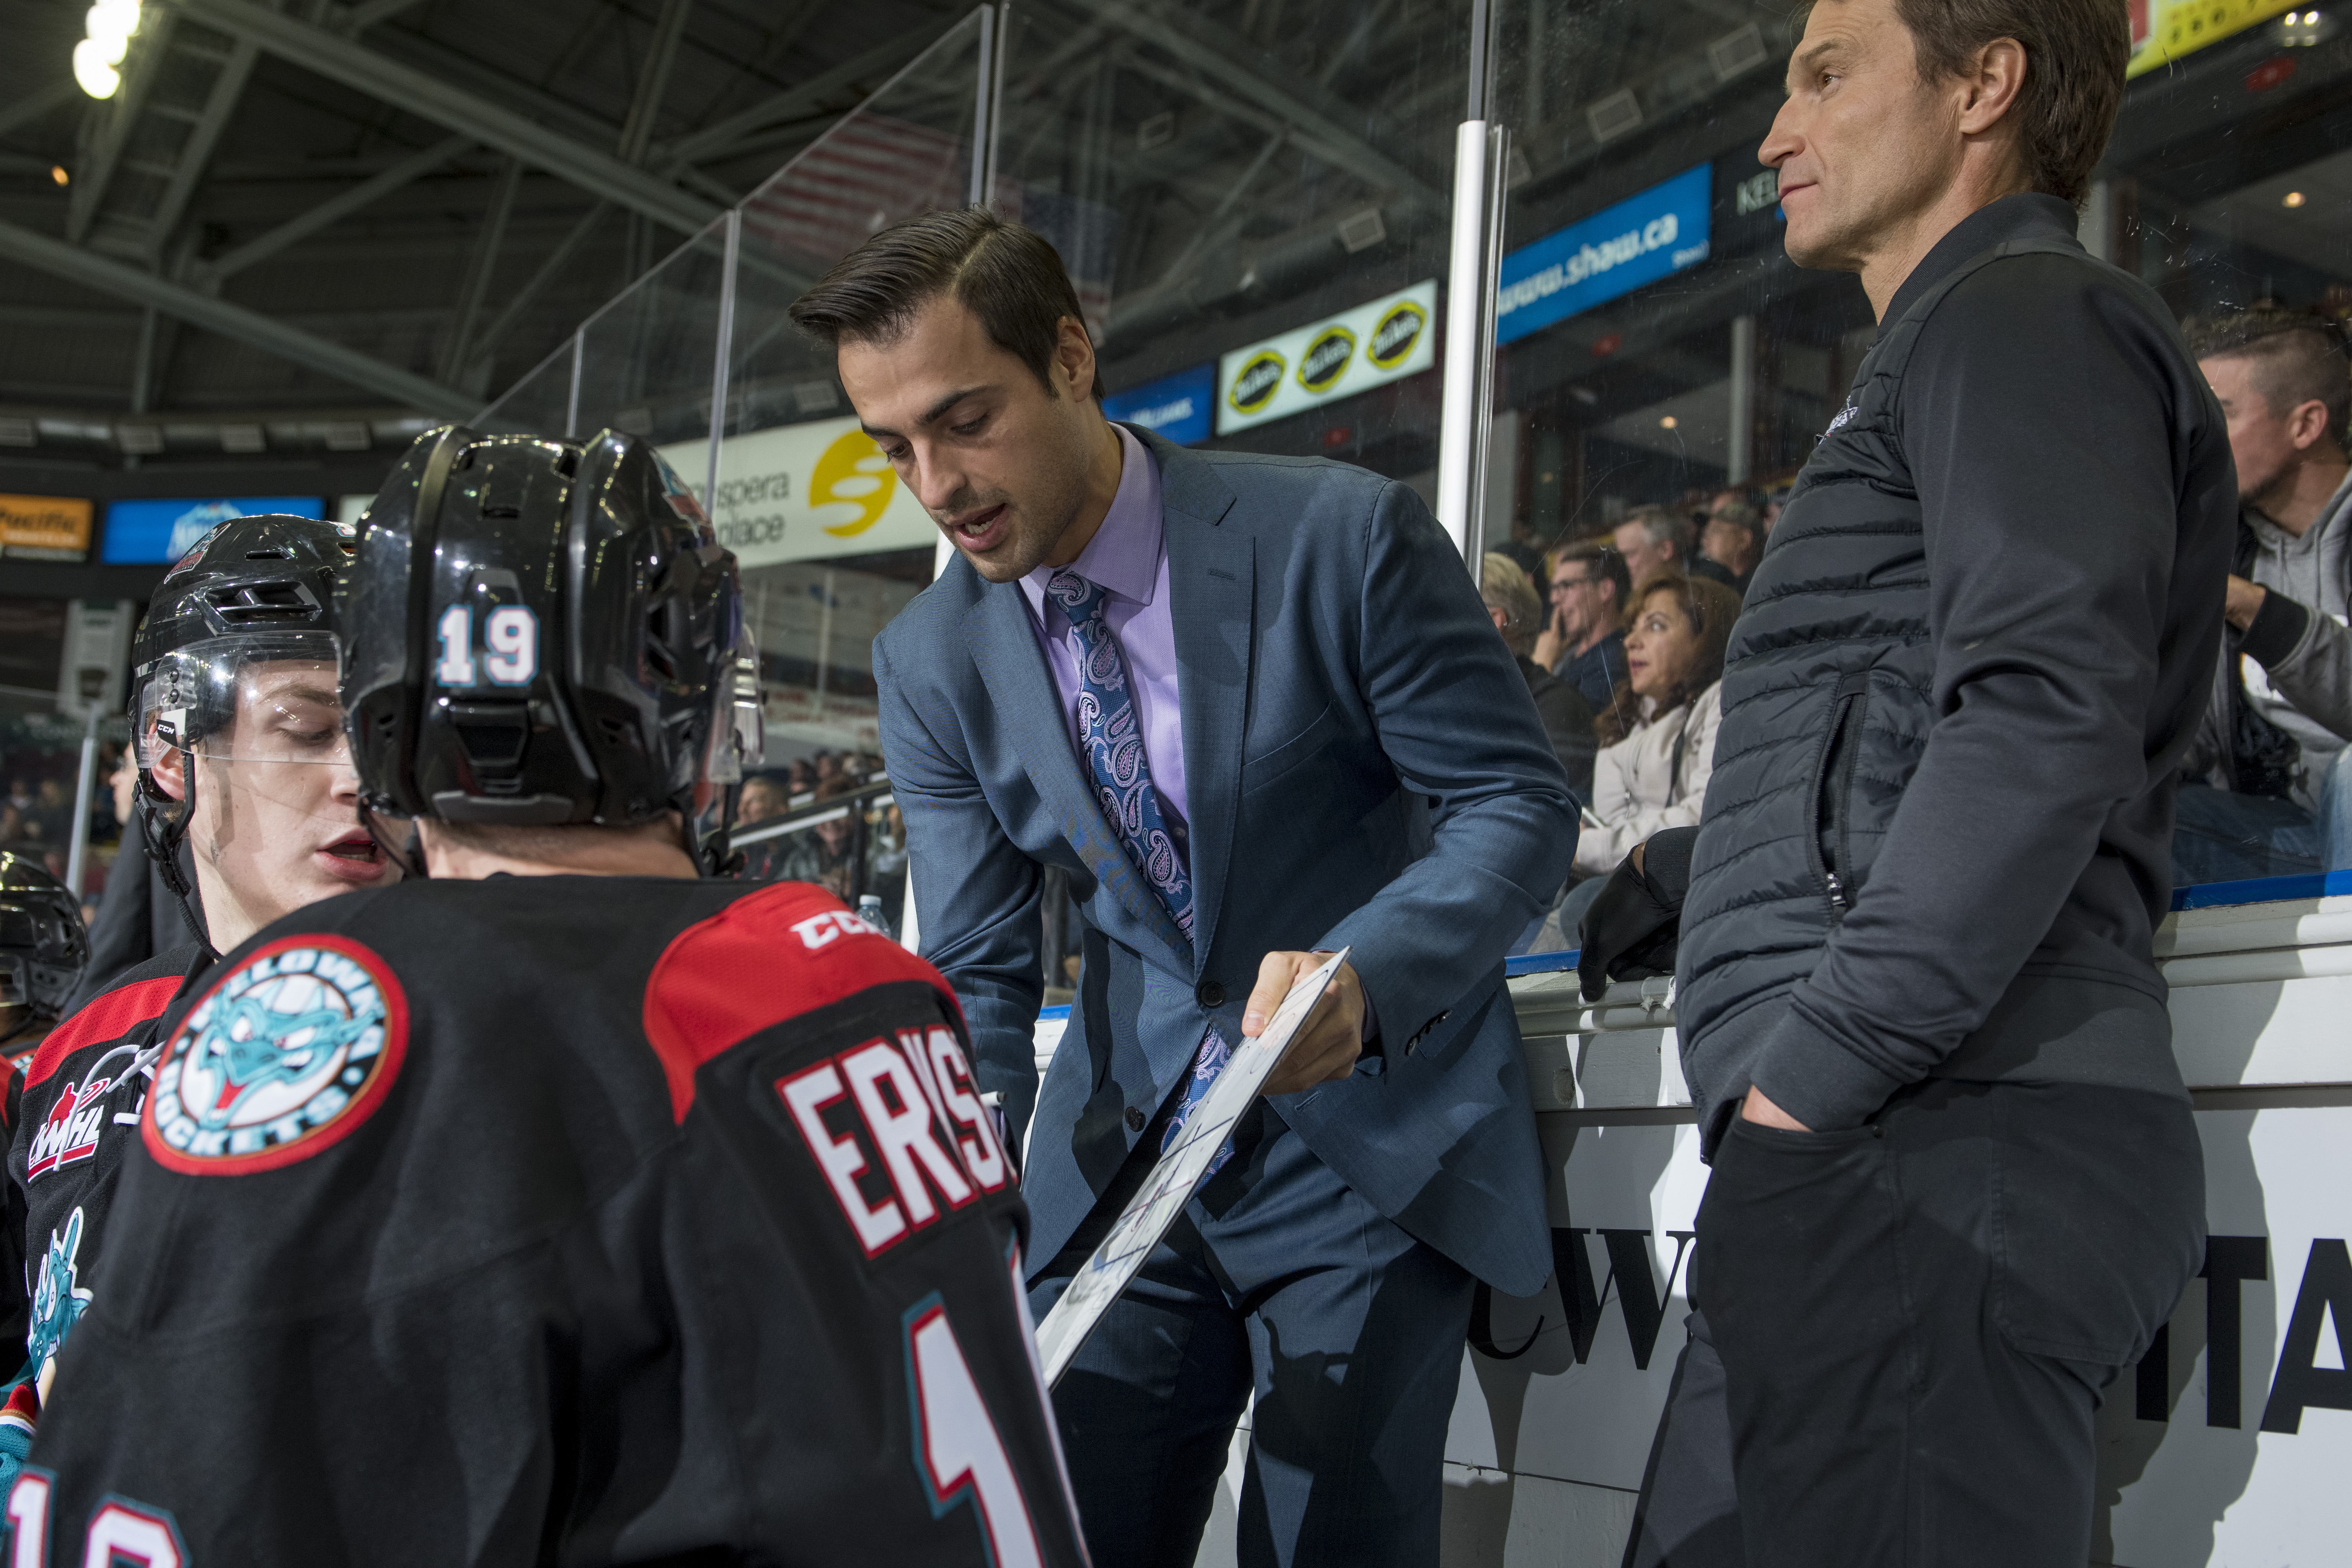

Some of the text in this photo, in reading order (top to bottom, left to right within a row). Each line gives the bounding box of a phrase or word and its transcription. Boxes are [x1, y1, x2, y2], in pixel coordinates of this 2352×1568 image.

[1737, 169, 1779, 216] KEL
[437, 604, 540, 687] 19
[157, 724, 175, 734] CCM
[34, 1105, 104, 1163] WHL
[154, 1058, 349, 1156] ROCKETS
[773, 1023, 1018, 1261] ERIS
